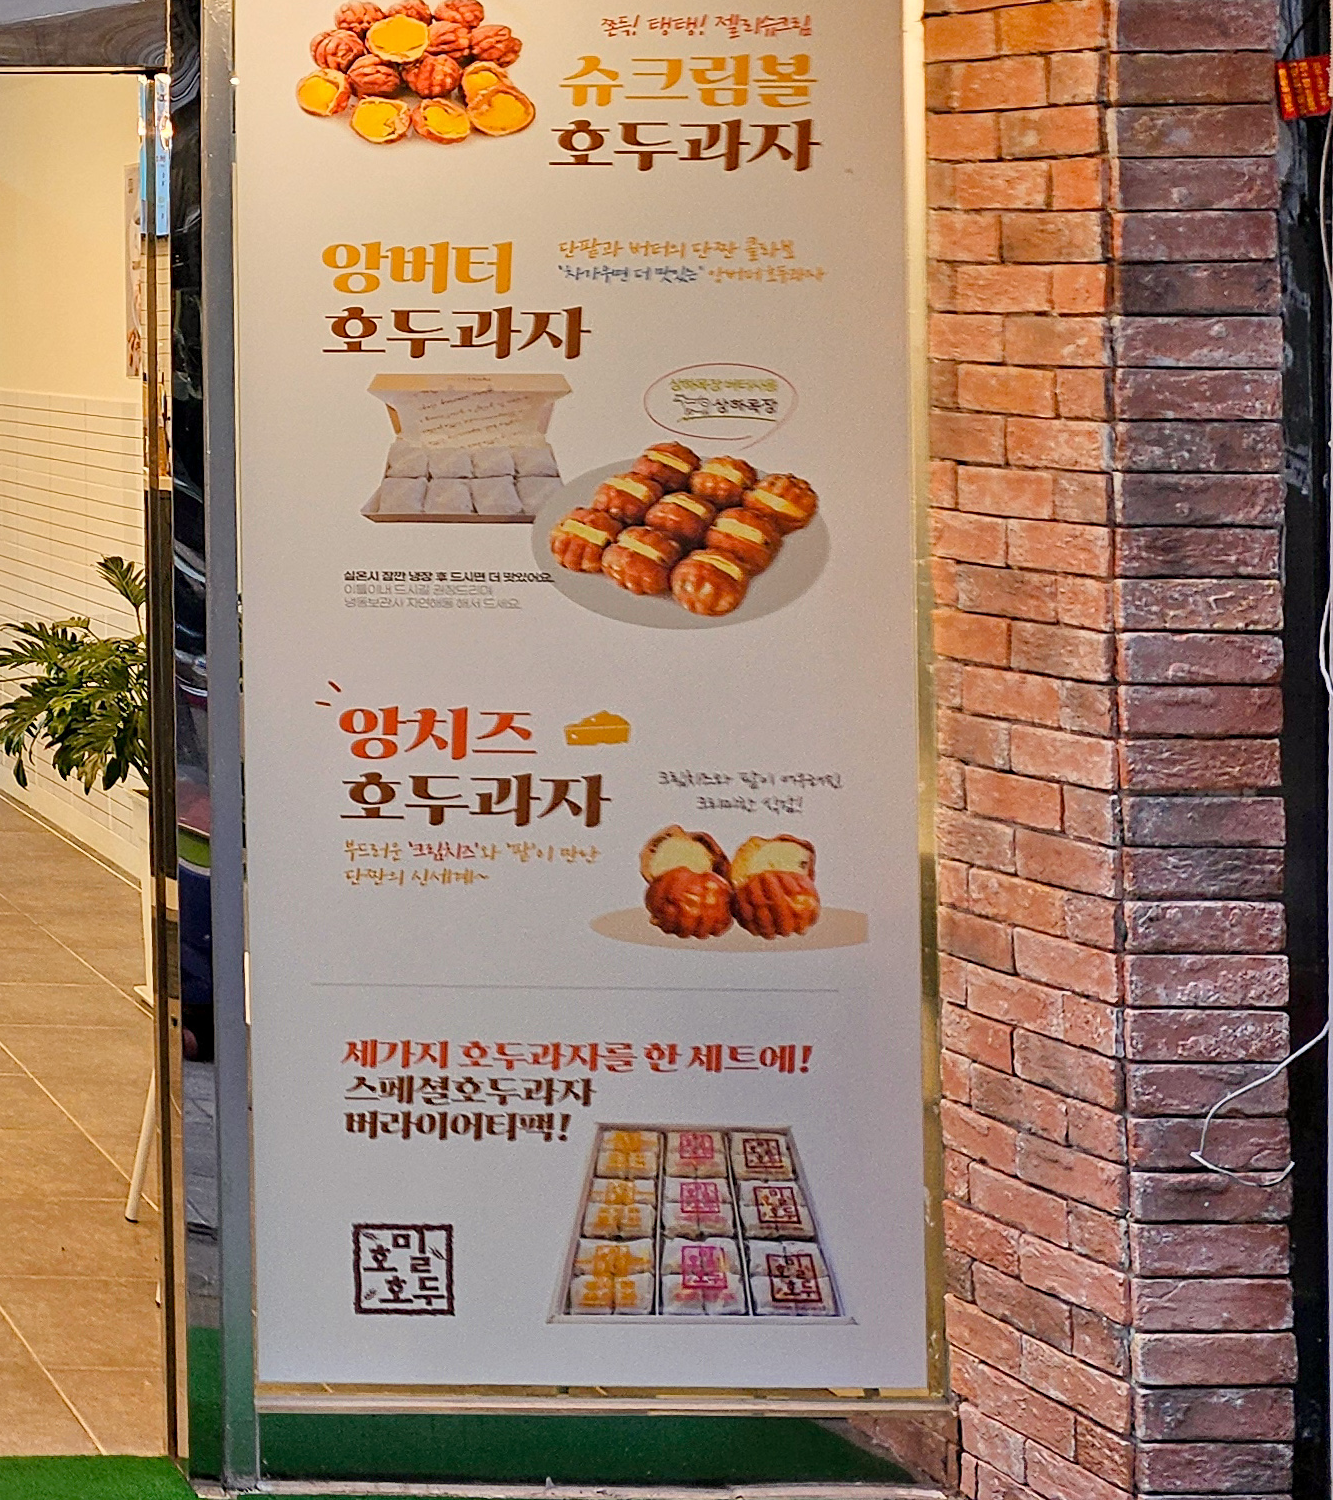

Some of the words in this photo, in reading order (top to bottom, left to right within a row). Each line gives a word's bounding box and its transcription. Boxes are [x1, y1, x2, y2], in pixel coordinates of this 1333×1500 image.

[559, 54, 818, 108] 슈크림볼
[549, 119, 822, 172] 호두과자
[322, 241, 513, 294] 앙버터
[323, 306, 592, 360] 호두과자
[344, 571, 379, 581] 실온시
[382, 571, 406, 581] 잠깐
[450, 571, 485, 582] 드시면
[489, 572, 501, 582] 더
[339, 706, 537, 760] 앙치즈
[340, 771, 612, 827] 호두과자
[344, 839, 402, 862] 부드러운
[341, 1039, 449, 1071] 세가지
[458, 1039, 638, 1073] 호두과자를
[644, 1043, 679, 1073] 한
[690, 1043, 813, 1074] 세트에!
[345, 1076, 597, 1108] 스페셜호두과자
[345, 1110, 571, 1142] 버라이어티팩!
[364, 1232, 430, 1274] 호밀
[379, 1277, 446, 1304] 호두
